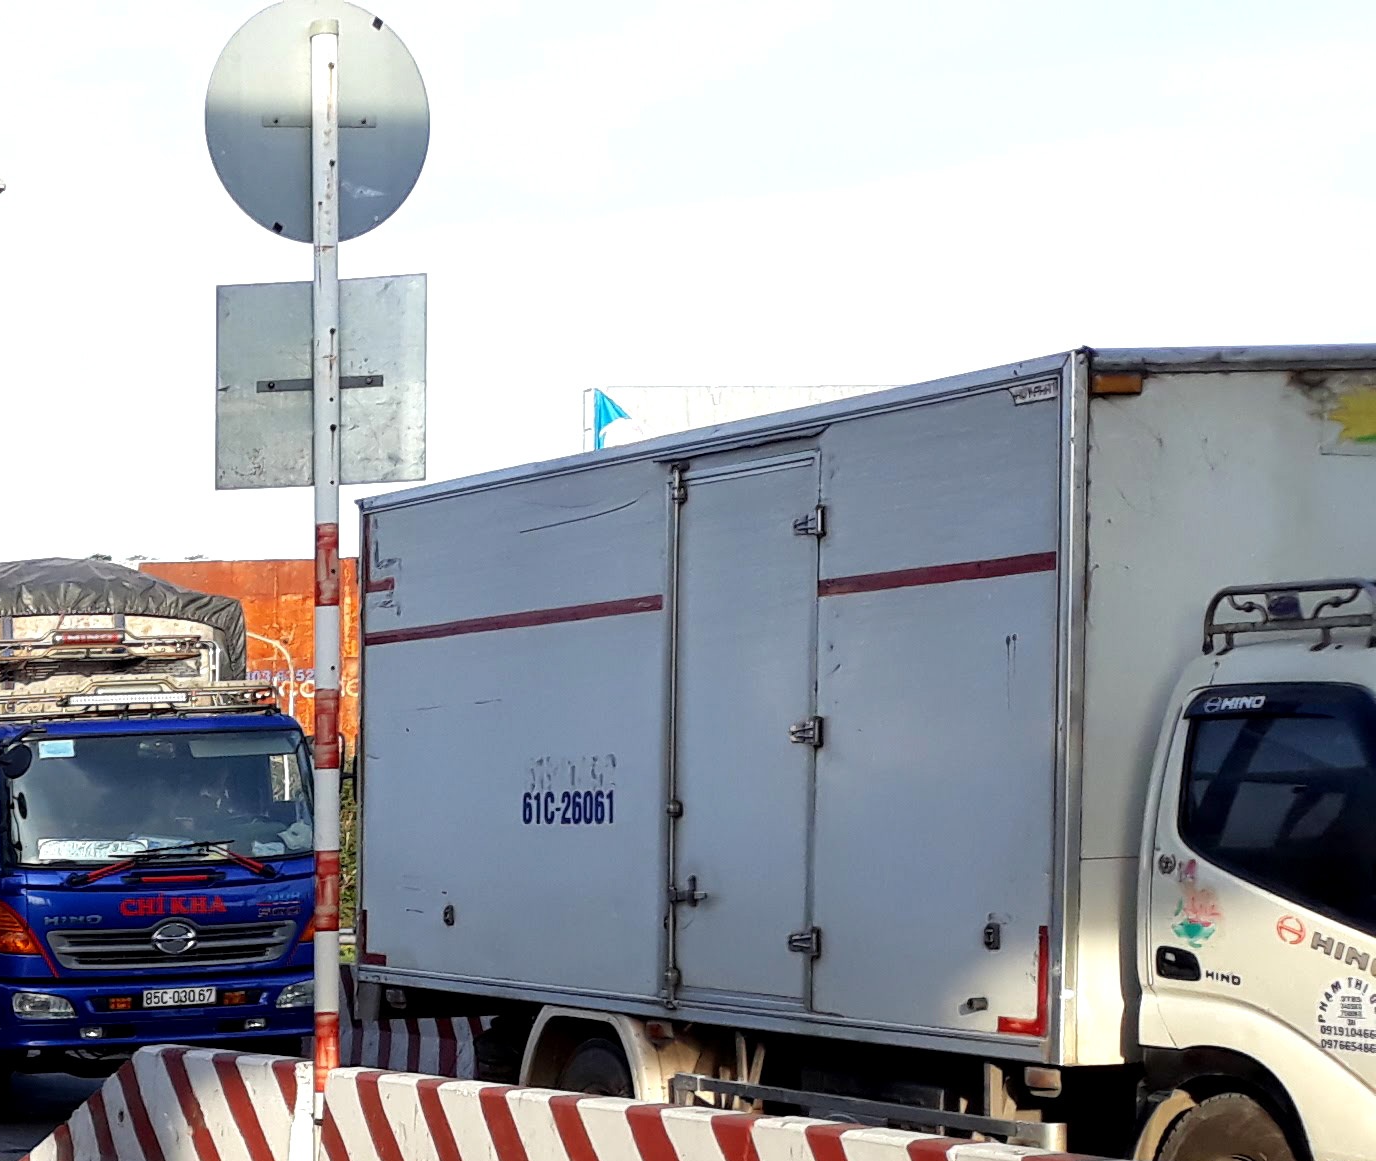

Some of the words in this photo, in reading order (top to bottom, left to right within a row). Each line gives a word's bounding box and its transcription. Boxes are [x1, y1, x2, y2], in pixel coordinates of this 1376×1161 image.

[1220, 696, 1266, 710] HINO
[523, 790, 614, 824] 61C-26061
[170, 896, 227, 915] KHA
[1205, 970, 1241, 986] HINO
